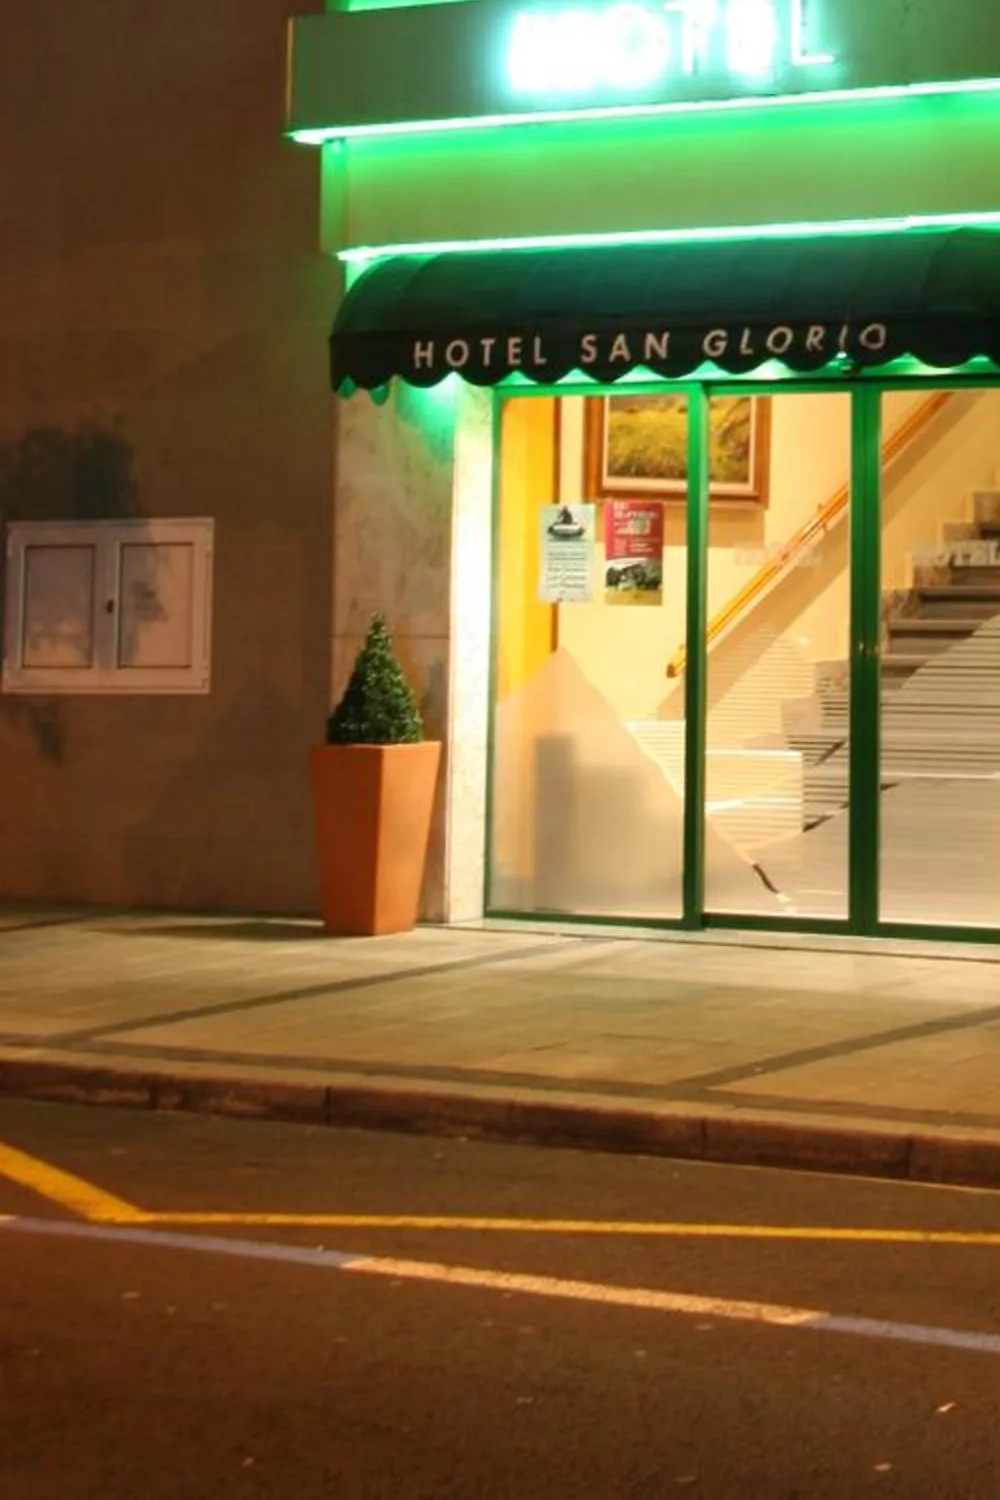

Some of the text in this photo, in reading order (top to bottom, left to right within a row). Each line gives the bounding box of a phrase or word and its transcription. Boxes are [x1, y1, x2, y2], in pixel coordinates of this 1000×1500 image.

[413, 323, 887, 369] HOTEL SAN GLORIO
